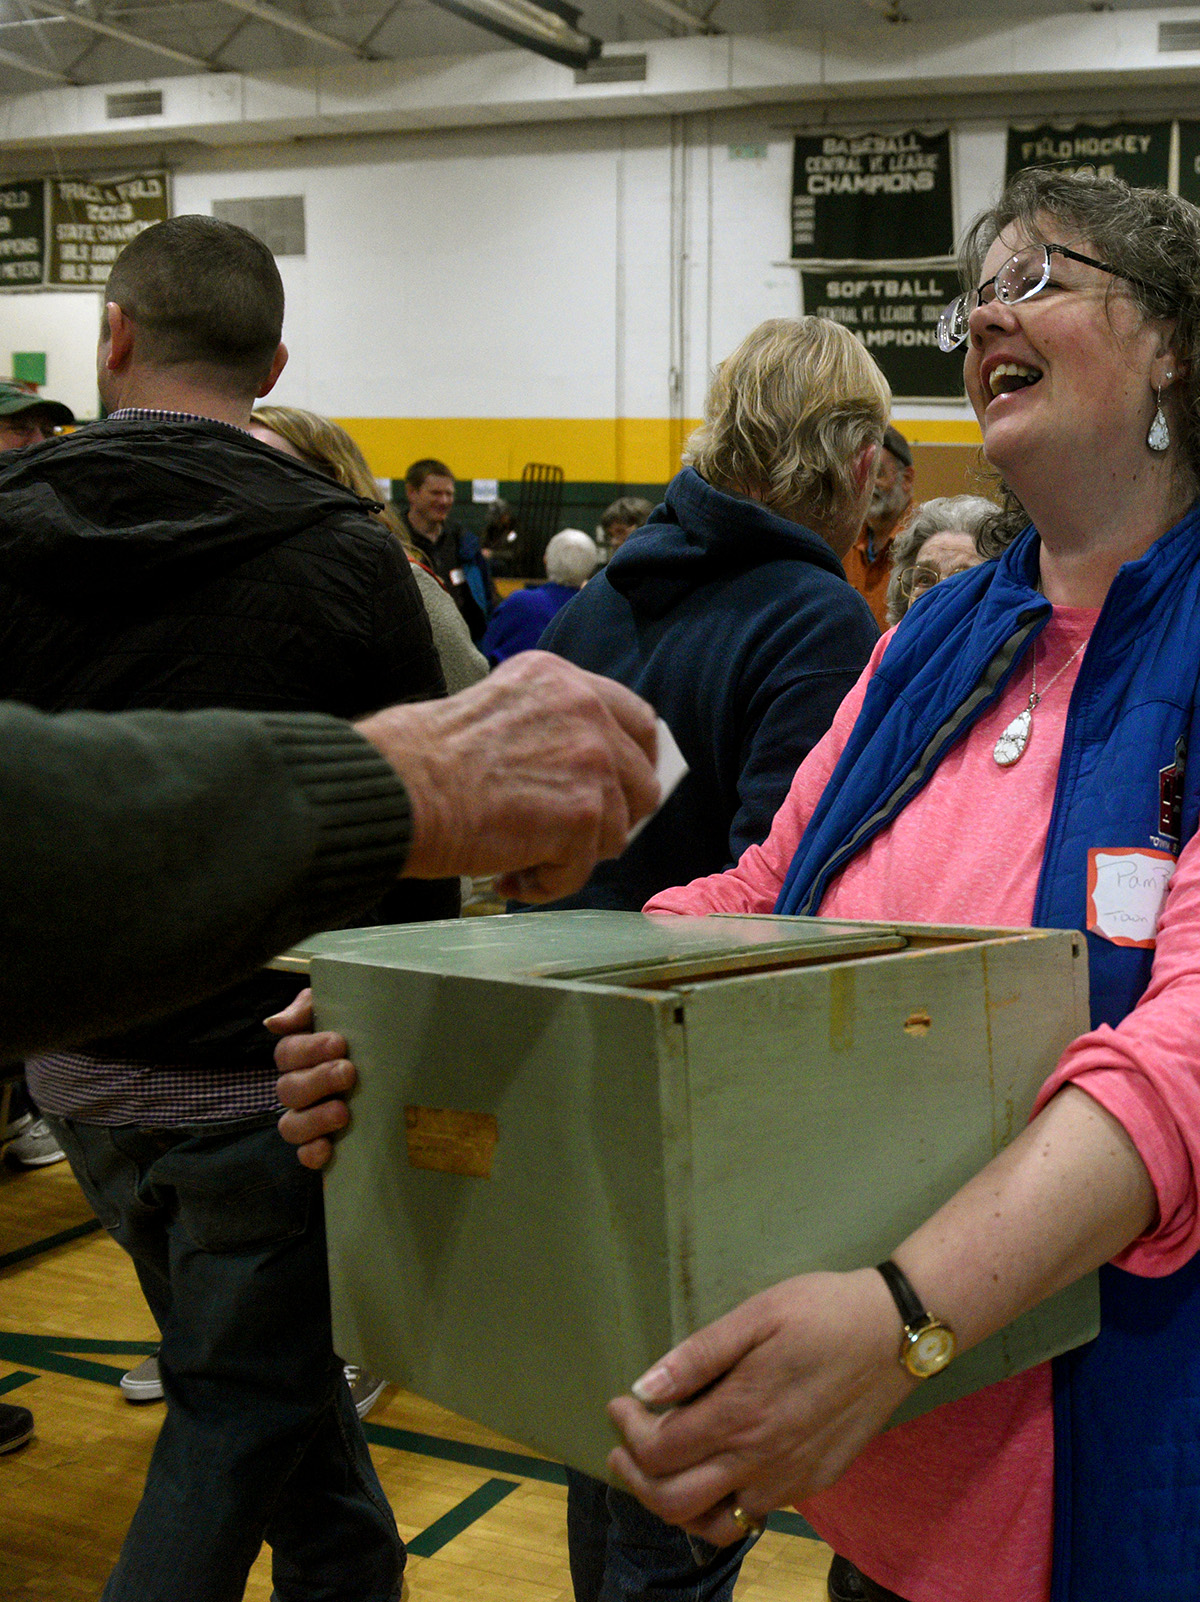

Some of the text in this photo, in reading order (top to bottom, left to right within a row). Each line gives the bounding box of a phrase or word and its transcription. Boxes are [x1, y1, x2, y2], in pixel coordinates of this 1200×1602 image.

[1074, 134, 1151, 157] HOCKEY
[805, 155, 862, 174] CENTRAL
[889, 153, 939, 171] LEAGUE
[116, 178, 163, 201] FIELD
[807, 171, 935, 195] CHAMPIONS
[826, 278, 944, 299] SOFTBALL
[879, 305, 915, 323] LEAGUE
[855, 328, 939, 347] AMPION
[1097, 861, 1157, 888] Pam
[1104, 911, 1147, 922] Town
